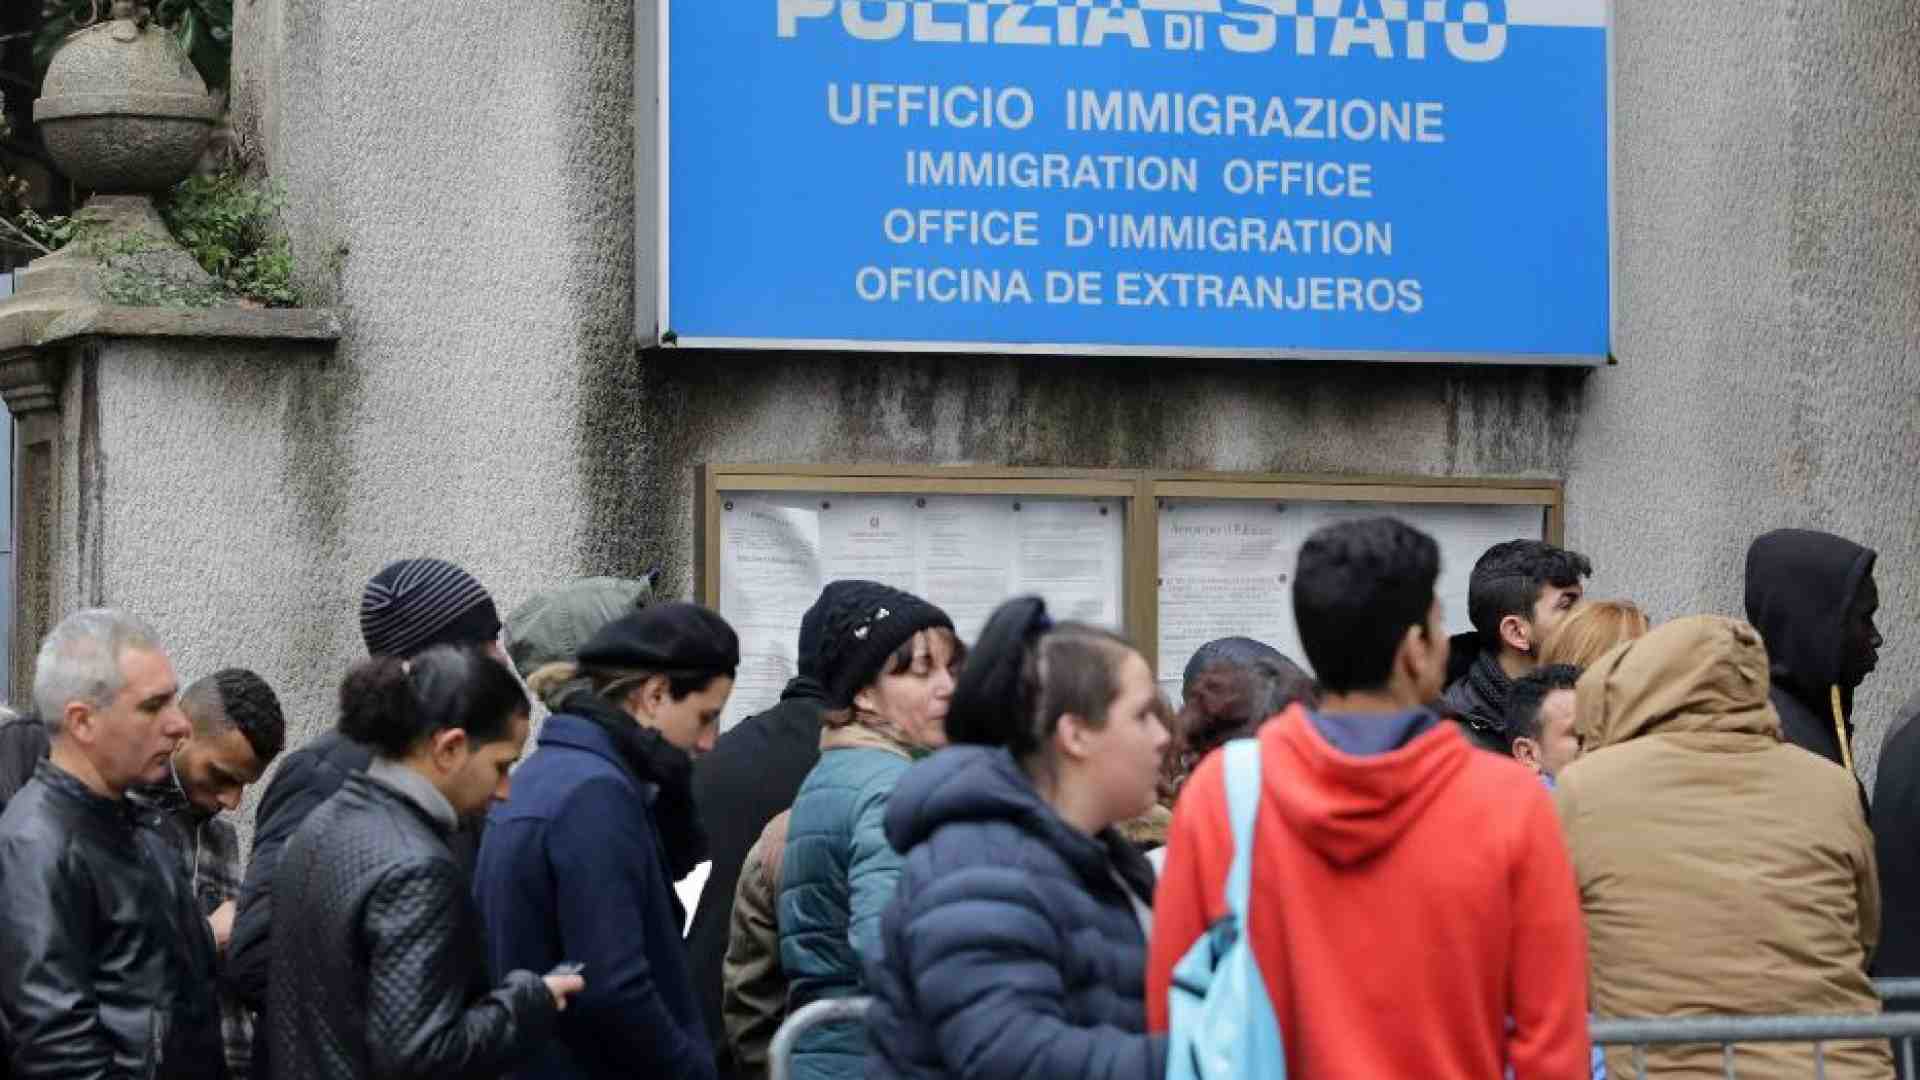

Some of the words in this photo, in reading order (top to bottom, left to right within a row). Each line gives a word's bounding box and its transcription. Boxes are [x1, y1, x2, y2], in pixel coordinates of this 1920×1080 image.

[1164, 13, 1204, 50] DI
[1219, 0, 1507, 62] STATO
[828, 83, 1035, 129] UFFICIO
[1067, 90, 1444, 143] IMMIGRAZIONE
[906, 151, 1197, 192] IMMIGRATION
[1224, 159, 1372, 197] OFFICE
[884, 208, 1039, 246] OFFICE
[1066, 213, 1392, 255] D'IMMIGRATION
[856, 266, 1031, 304] OFICINA
[1046, 272, 1102, 305] DE
[1117, 273, 1423, 313] EXTRANJEROS
